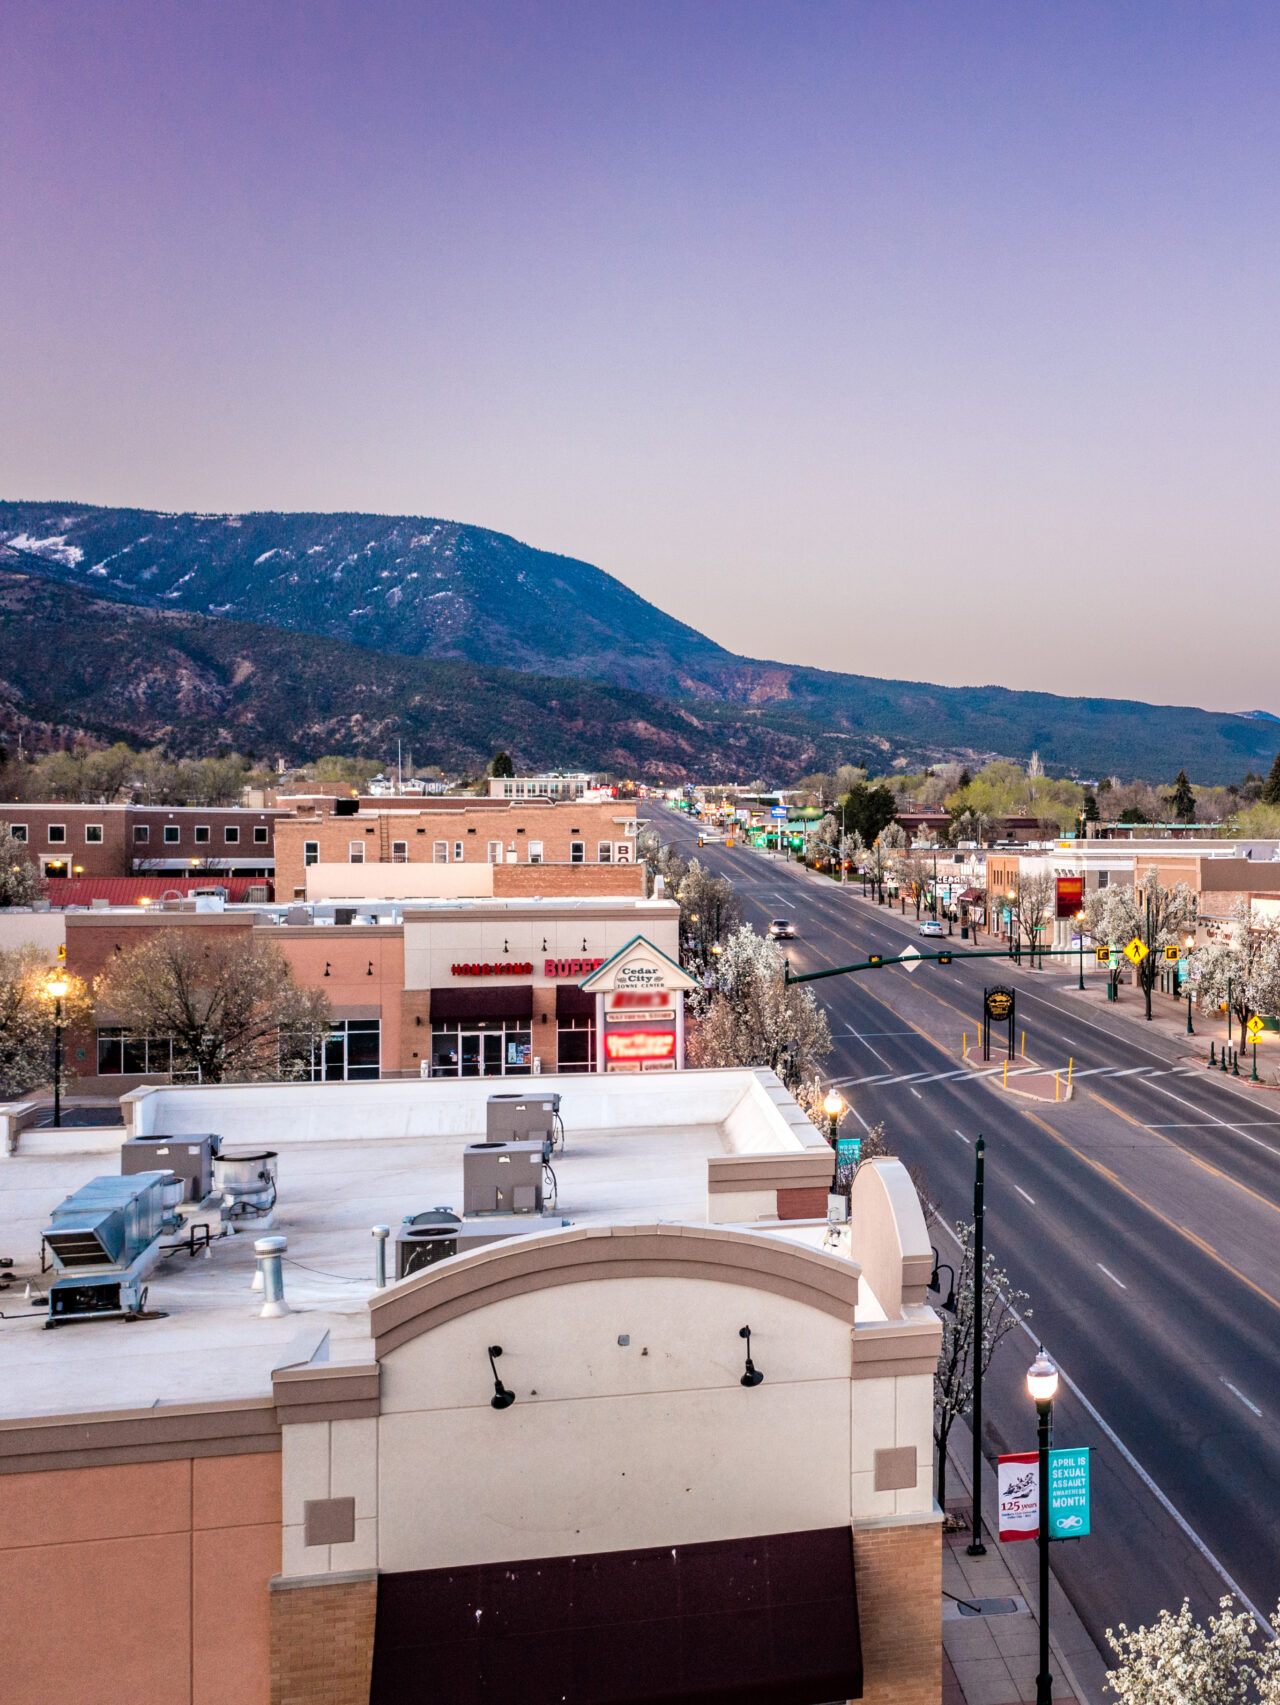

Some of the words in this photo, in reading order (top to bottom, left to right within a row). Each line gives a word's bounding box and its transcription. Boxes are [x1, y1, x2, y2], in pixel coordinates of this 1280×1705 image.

[451, 963, 490, 976] HONG
[494, 962, 533, 975] KONG
[544, 958, 608, 977] BUFFE
[628, 975, 653, 983] City
[1052, 1459, 1075, 1468] APRIL
[1078, 1457, 1086, 1465] IS
[1052, 1468, 1086, 1478] SEXUAL
[1052, 1478, 1086, 1488] ASSAULT
[1052, 1488, 1086, 1496] AWARENESS
[1001, 1501, 1020, 1511] 125
[1021, 1502, 1037, 1511] years
[1052, 1496, 1086, 1508] MONTH
